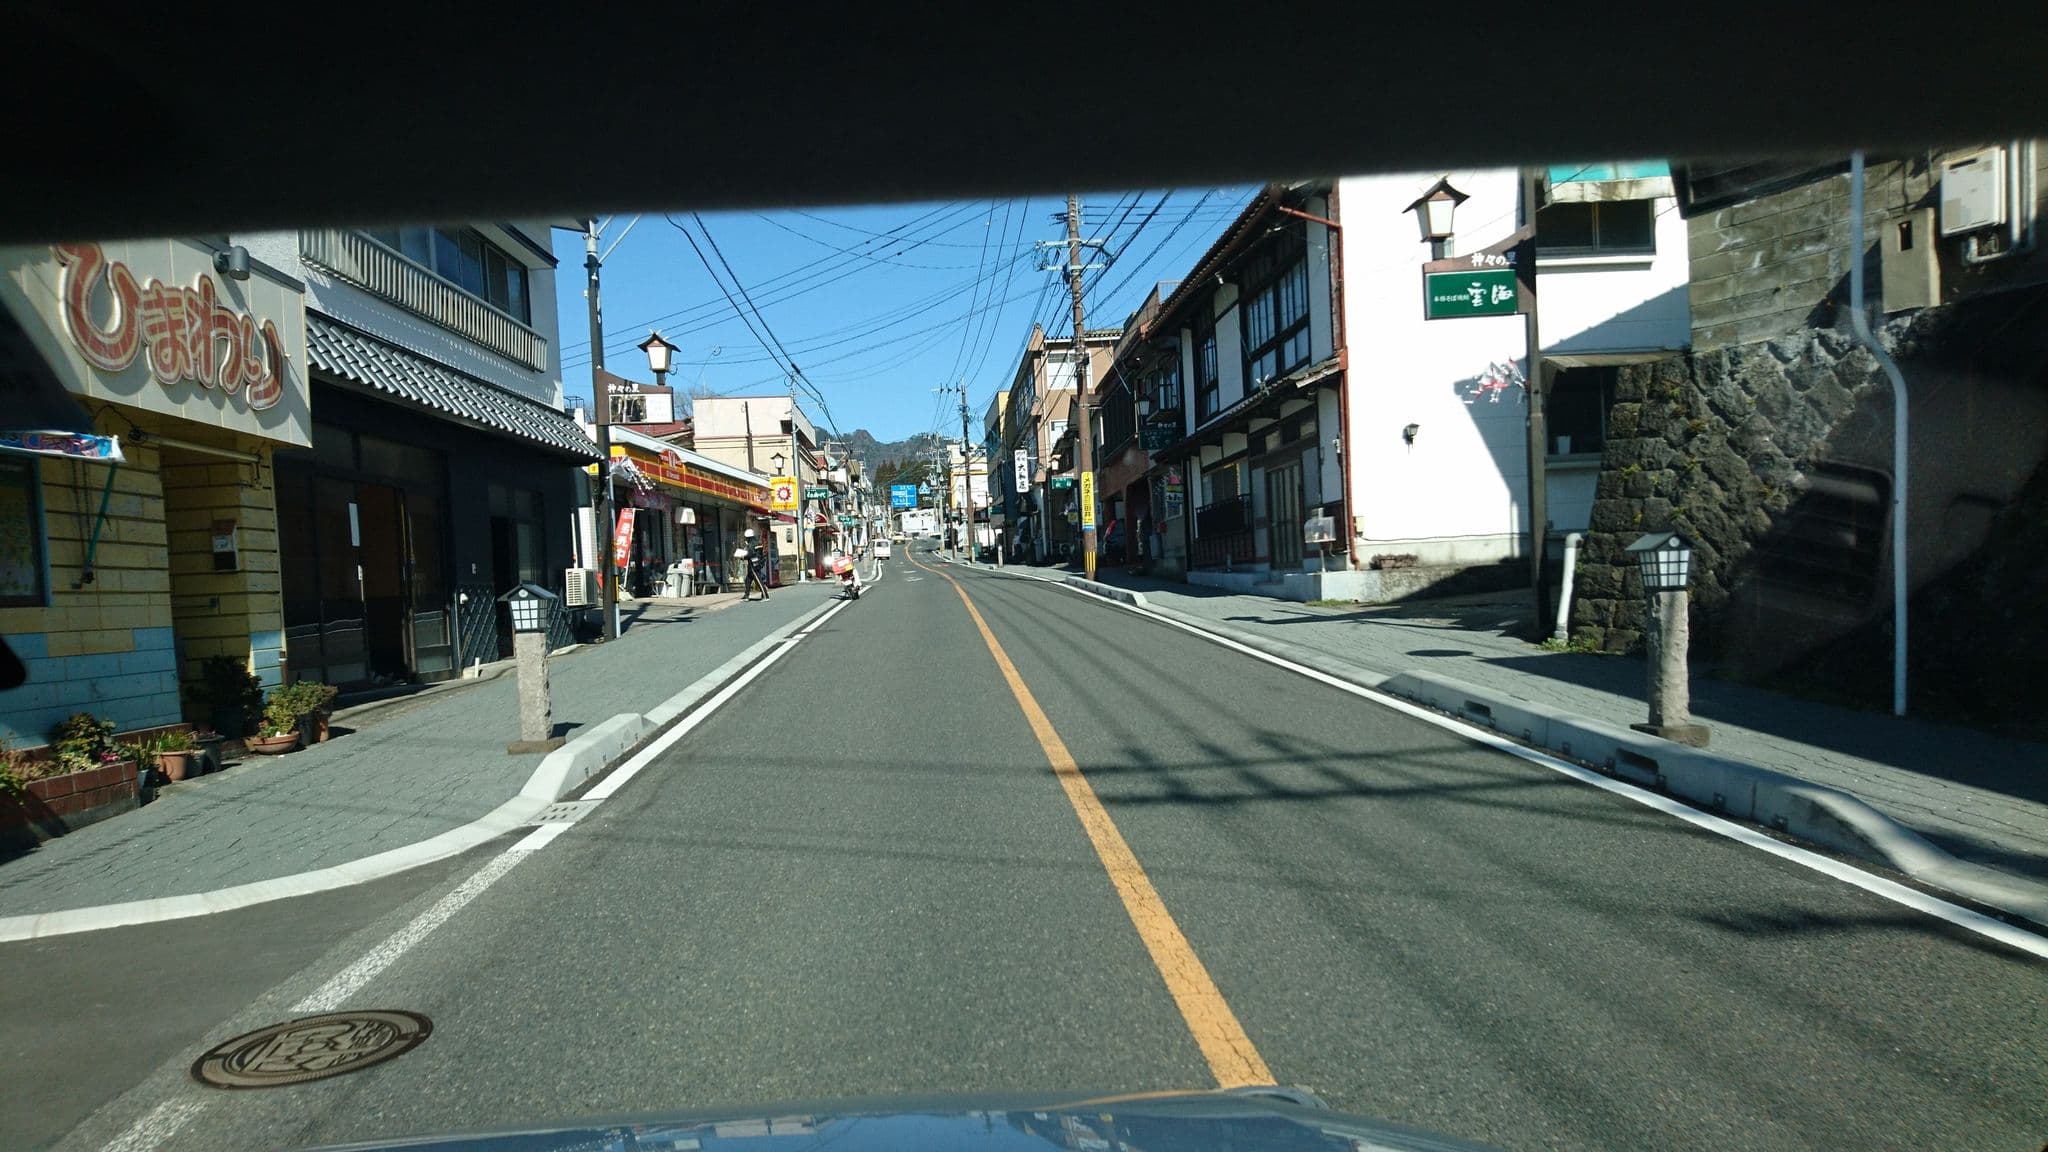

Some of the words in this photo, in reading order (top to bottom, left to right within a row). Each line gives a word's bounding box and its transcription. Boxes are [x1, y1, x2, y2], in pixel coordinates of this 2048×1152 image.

[1467, 282, 1515, 307] 雲海
[51, 243, 283, 410] ひまわり
[607, 383, 639, 393] 神々の里
